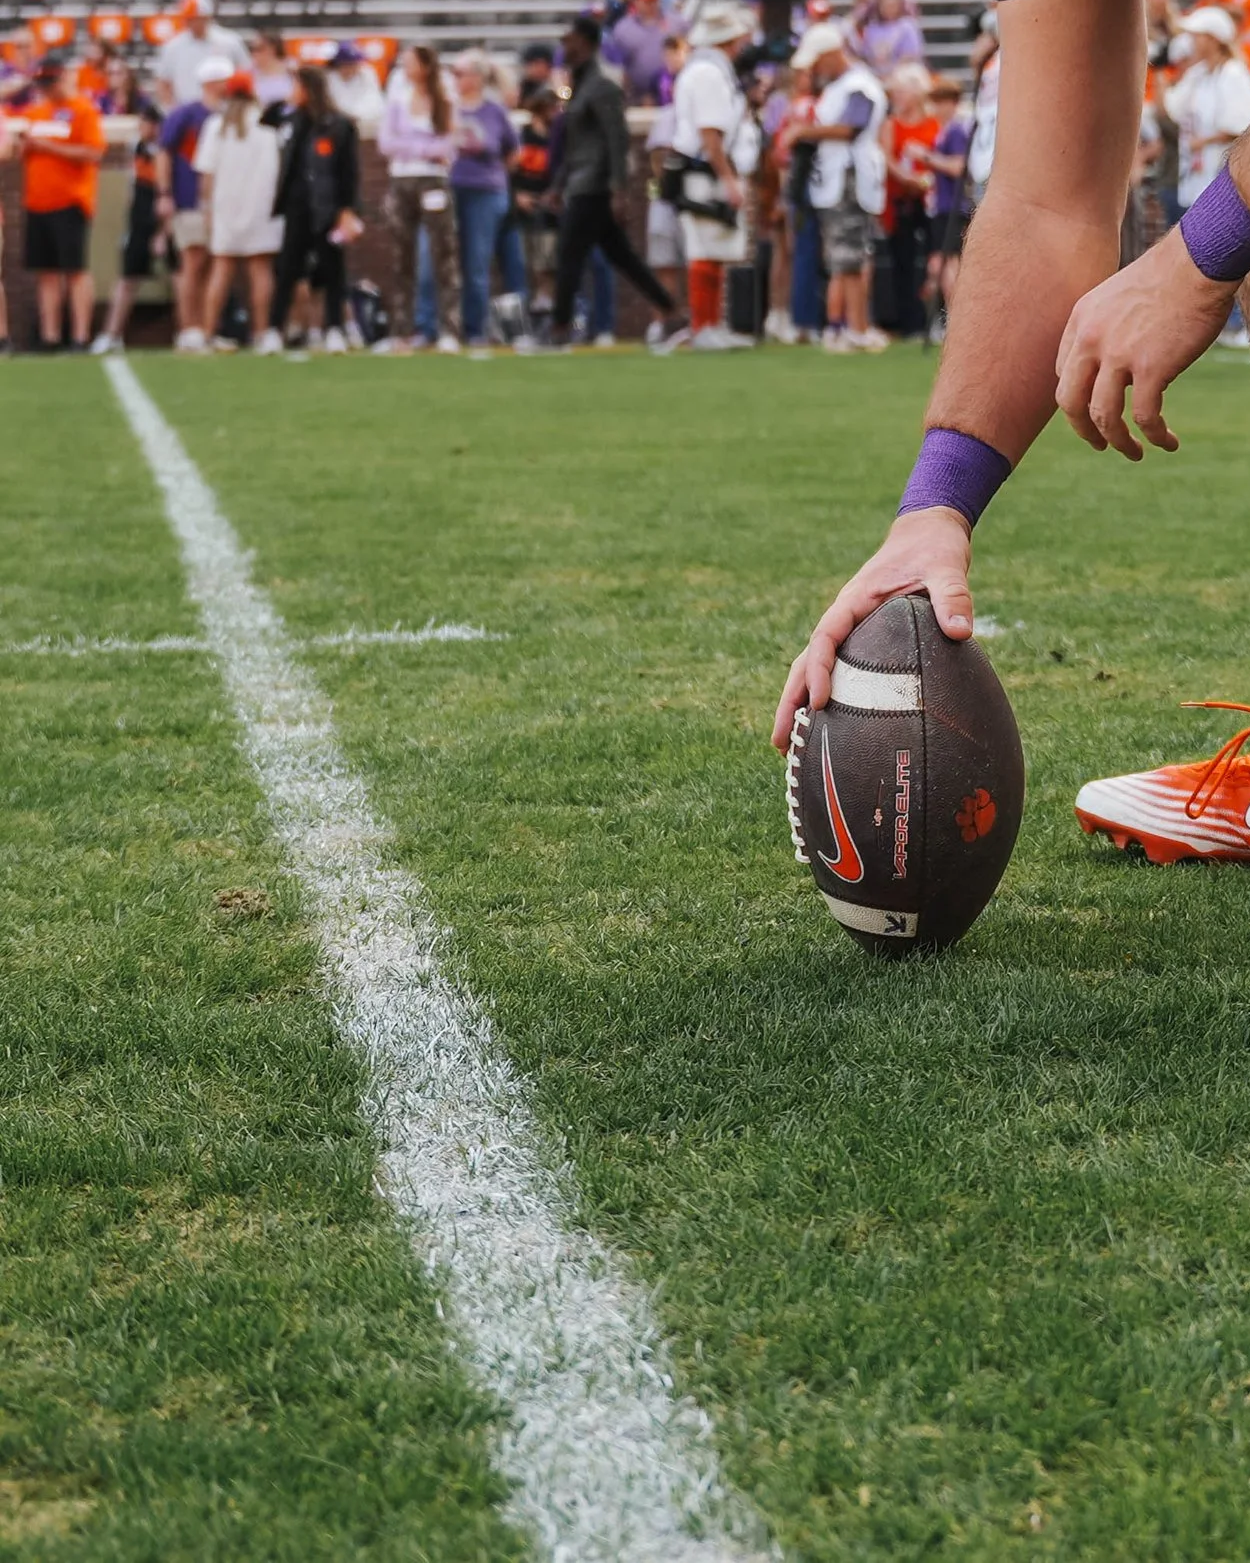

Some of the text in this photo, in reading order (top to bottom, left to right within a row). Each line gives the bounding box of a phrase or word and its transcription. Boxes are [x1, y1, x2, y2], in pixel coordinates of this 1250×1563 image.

[893, 749, 910, 879] VAPOR ELITE
[885, 914, 907, 934] K
